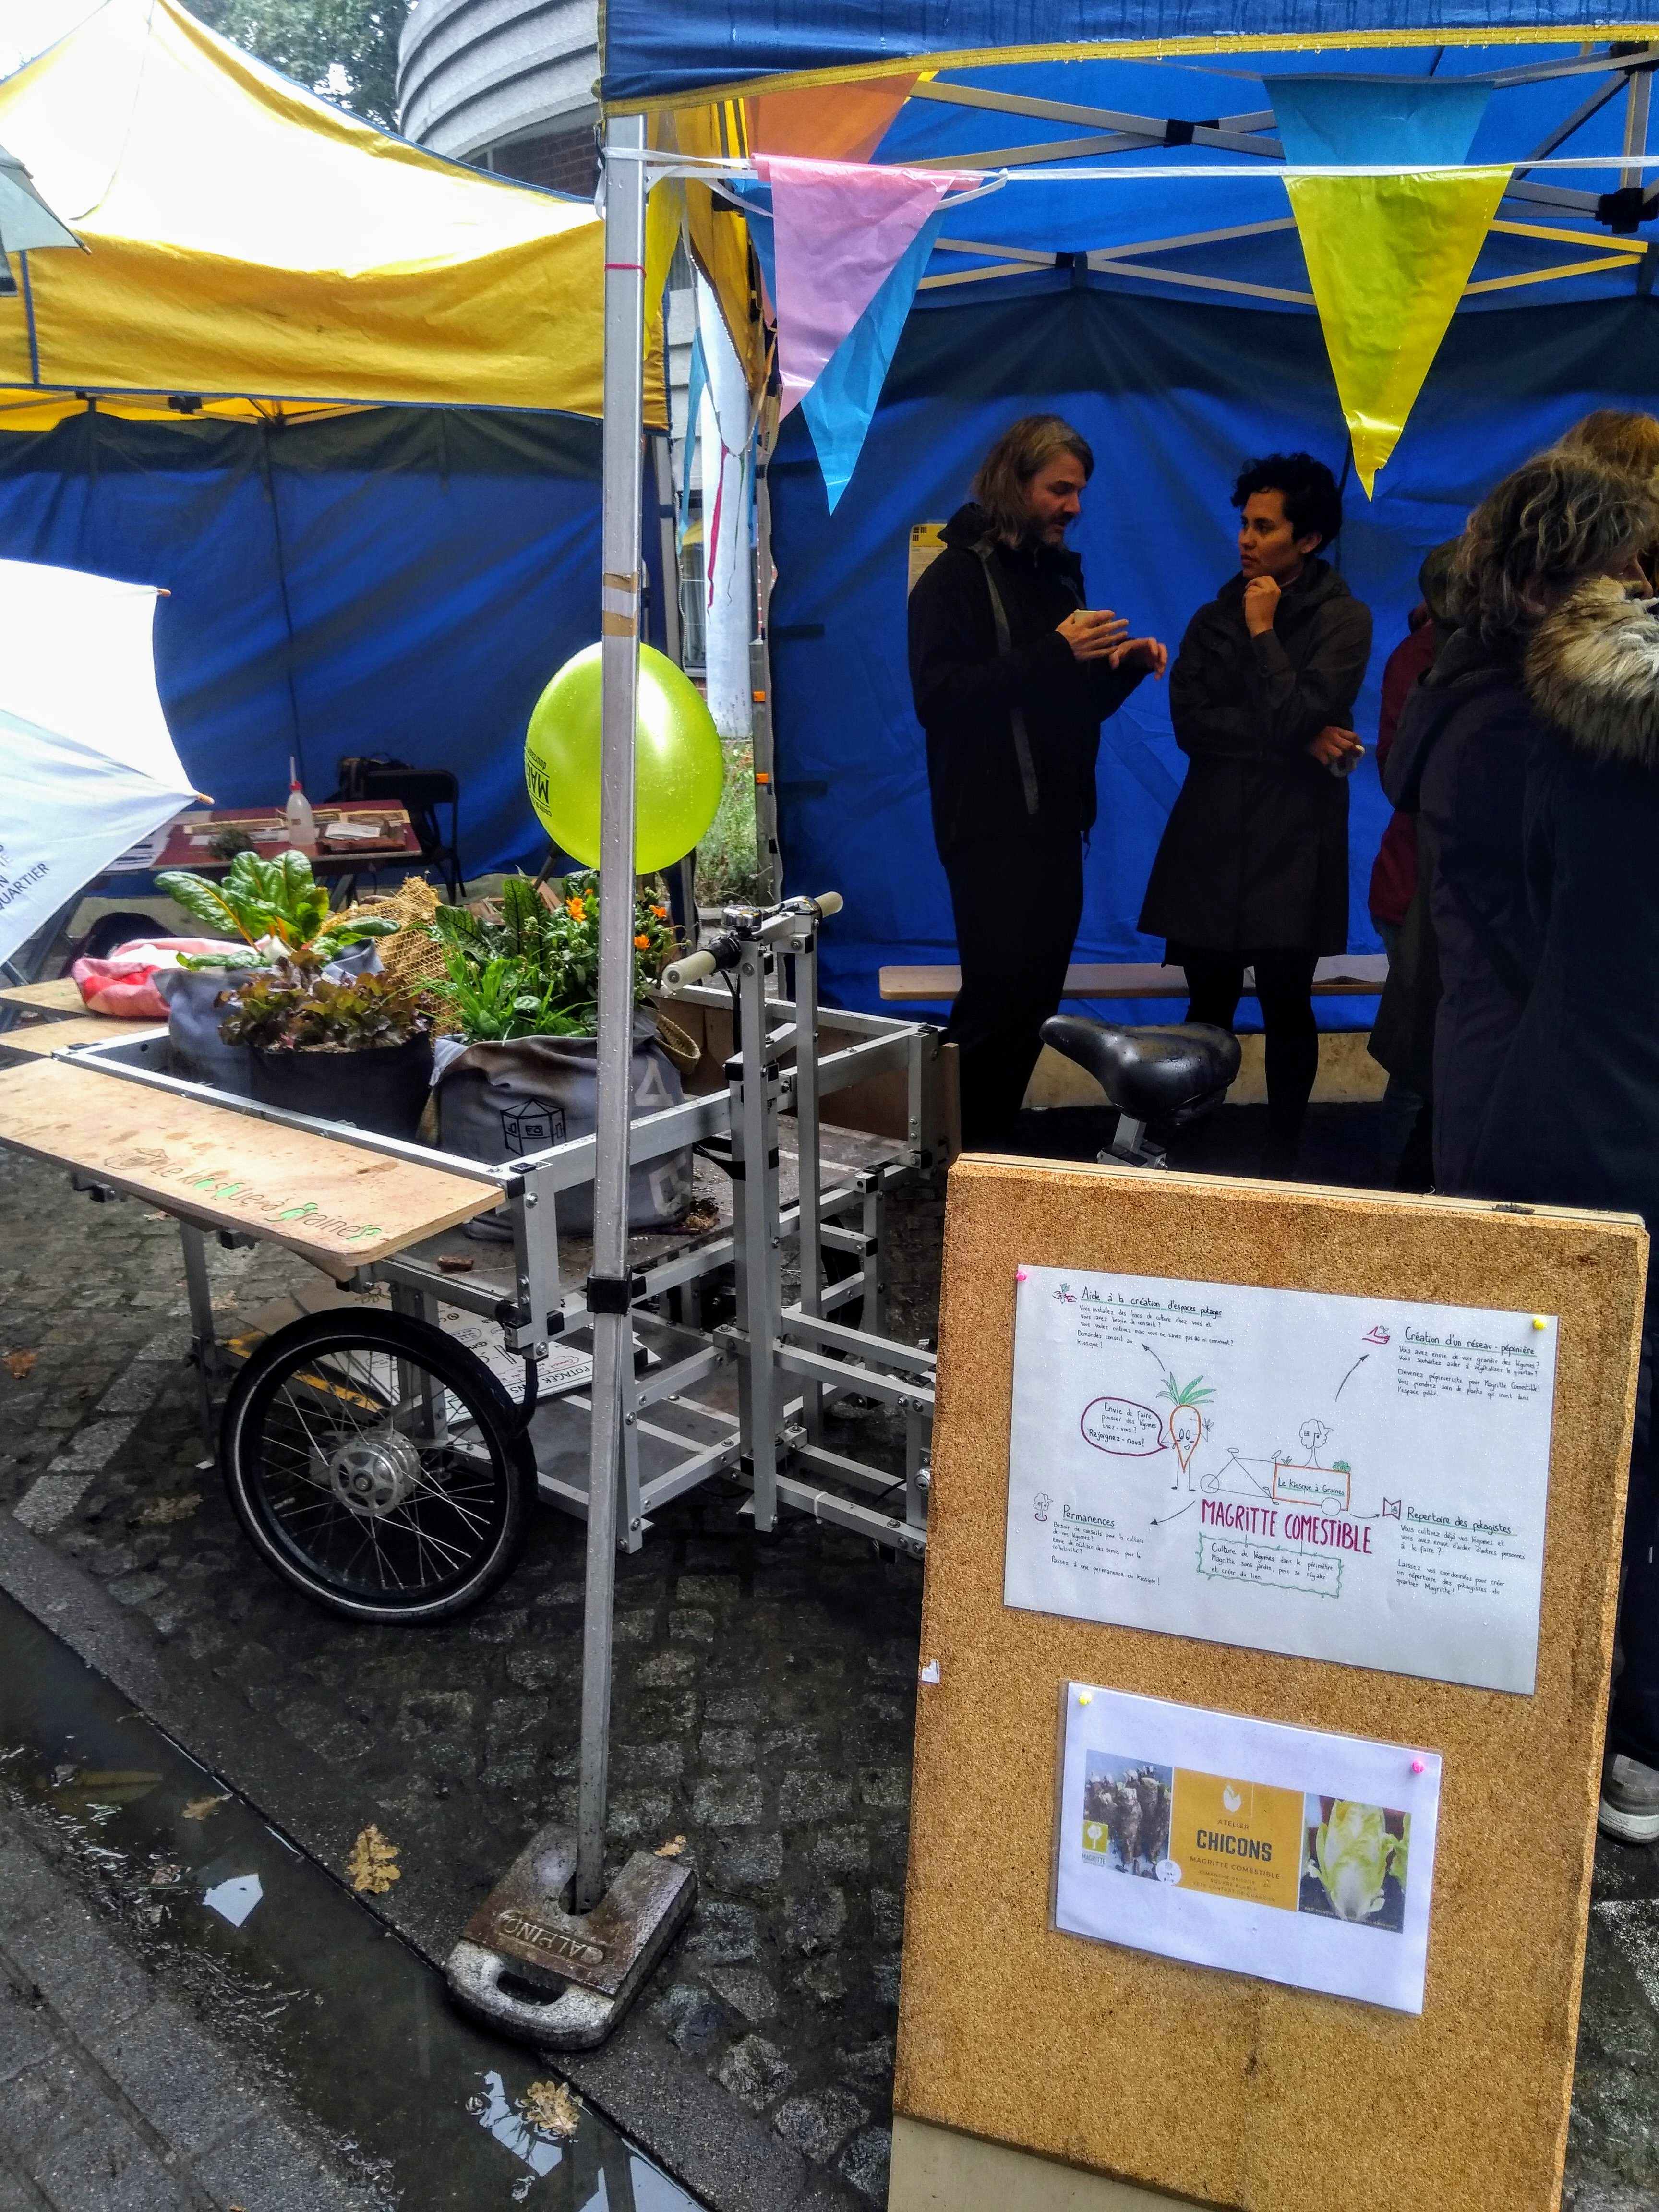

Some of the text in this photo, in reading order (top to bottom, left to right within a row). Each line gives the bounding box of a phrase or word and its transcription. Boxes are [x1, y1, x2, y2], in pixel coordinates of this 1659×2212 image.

[1082, 1286, 1100, 1300] Aide
[1108, 1293, 1112, 1301] à
[1131, 1298, 1160, 1307] création
[1168, 1300, 1196, 1313] d'espaces
[1201, 1307, 1222, 1319] potager
[1093, 1307, 1114, 1315] installez
[1131, 1310, 1142, 1318] bacs
[1078, 1330, 1102, 1338] Demandez
[1405, 1327, 1439, 1343] Création
[1446, 1334, 1461, 1346] d'un
[541, 1366, 591, 1384] POTAGER
[1398, 1369, 1423, 1377] Devenez
[1485, 1380, 1506, 1391] Magritte
[1105, 1403, 1122, 1414] Envie
[1102, 1415, 1121, 1423] pousser
[1140, 1420, 1156, 1430] légumes
[1278, 1478, 1286, 1486] Le
[1322, 1485, 1345, 1494] Graines
[1063, 1505, 1115, 1527] Permanences
[1408, 1507, 1511, 1535] Repertoire des potagistes
[1418, 1527, 1440, 1536] cultivez
[1444, 1532, 1455, 1541] déjà
[1472, 1536, 1492, 1546] légumes
[1212, 1543, 1236, 1555] Culture
[1253, 1551, 1274, 1564] légumes
[1308, 1562, 1333, 1571] périmètre
[1502, 1551, 1525, 1560] personnes
[1052, 1556, 1069, 1565] Passez
[1094, 1567, 1124, 1576] permanence
[1398, 1559, 1420, 1571] Laissez
[1440, 1571, 1472, 1581] coordonnées
[1409, 1573, 1436, 1583] répertoire
[1457, 1584, 1487, 1593] potagistes
[1217, 1819, 1249, 1829] ATELIER
[1197, 1830, 1272, 1862] CHICONS
[1190, 1856, 1280, 1879] MAGRITTE COMESTIBLE
